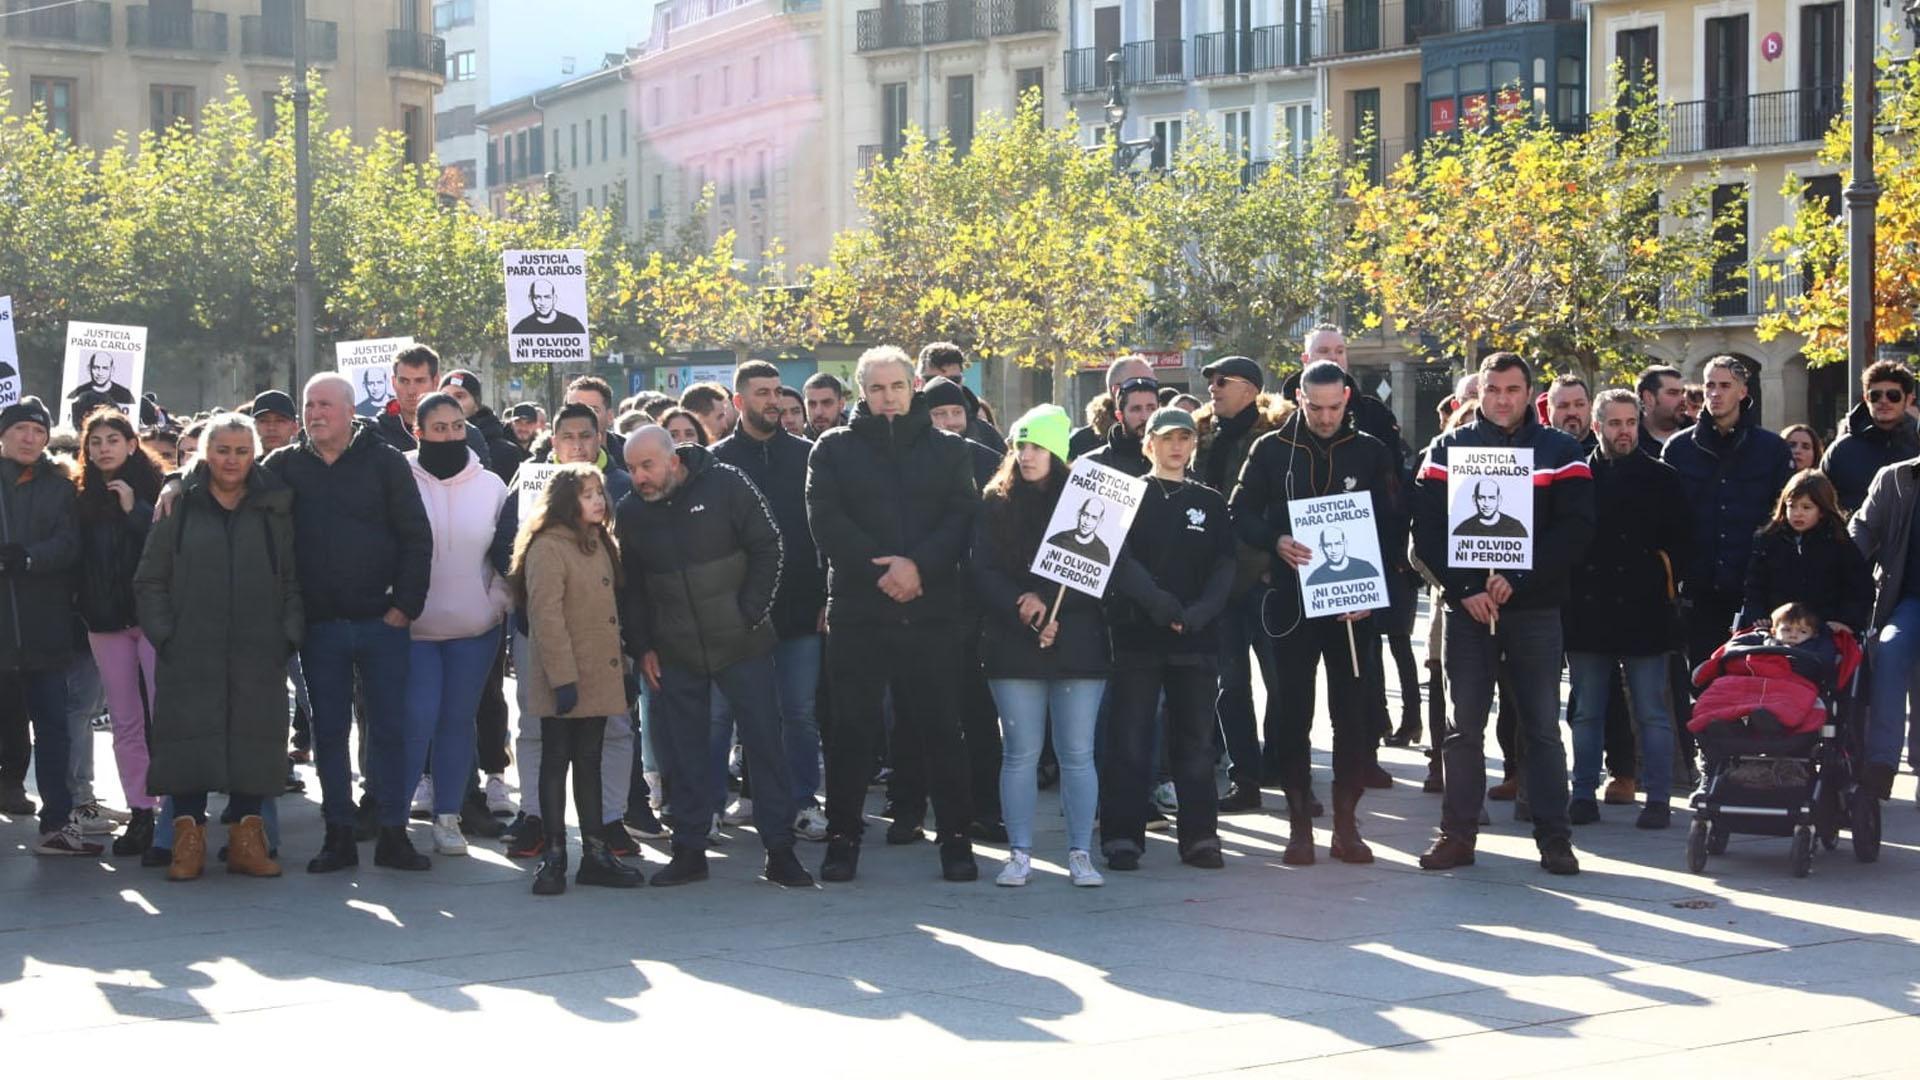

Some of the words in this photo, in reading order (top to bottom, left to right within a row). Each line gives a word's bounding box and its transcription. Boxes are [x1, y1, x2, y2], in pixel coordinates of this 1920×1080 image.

[519, 254, 569, 265] JUSTICIA
[507, 266, 536, 276] PARA
[538, 265, 582, 276] CARLOS
[84, 329, 131, 341] JUSTICIA
[71, 338, 98, 348] PARA
[100, 340, 142, 352] CARLOS
[518, 337, 533, 349] ¡NI
[537, 337, 580, 347] OLVIDO
[352, 343, 398, 356] JUSTICIA
[517, 349, 529, 358] NI
[342, 355, 368, 367] PARA
[1465, 454, 1517, 465] JUSTICIA
[1452, 465, 1481, 475] PARA
[1484, 466, 1530, 476] CARLOS
[523, 480, 543, 491] PAR
[1086, 468, 1131, 493] JUSTICIA
[1071, 474, 1096, 493] PARA
[1097, 485, 1137, 508] CARLOS
[1306, 498, 1356, 514] JUSTICIA
[1294, 514, 1324, 527] PARA
[1326, 508, 1370, 523] CARLOS
[1458, 540, 1473, 551] ¡NI
[1477, 540, 1522, 551] OLVIDO
[1455, 552, 1467, 561] NI
[1040, 559, 1054, 572] NI
[1045, 549, 1062, 561] ¡NI
[1063, 555, 1102, 577] OLVIDO
[1312, 587, 1328, 601] ¡NI
[1331, 581, 1375, 595] OLVIDO
[1311, 600, 1324, 611] NI
